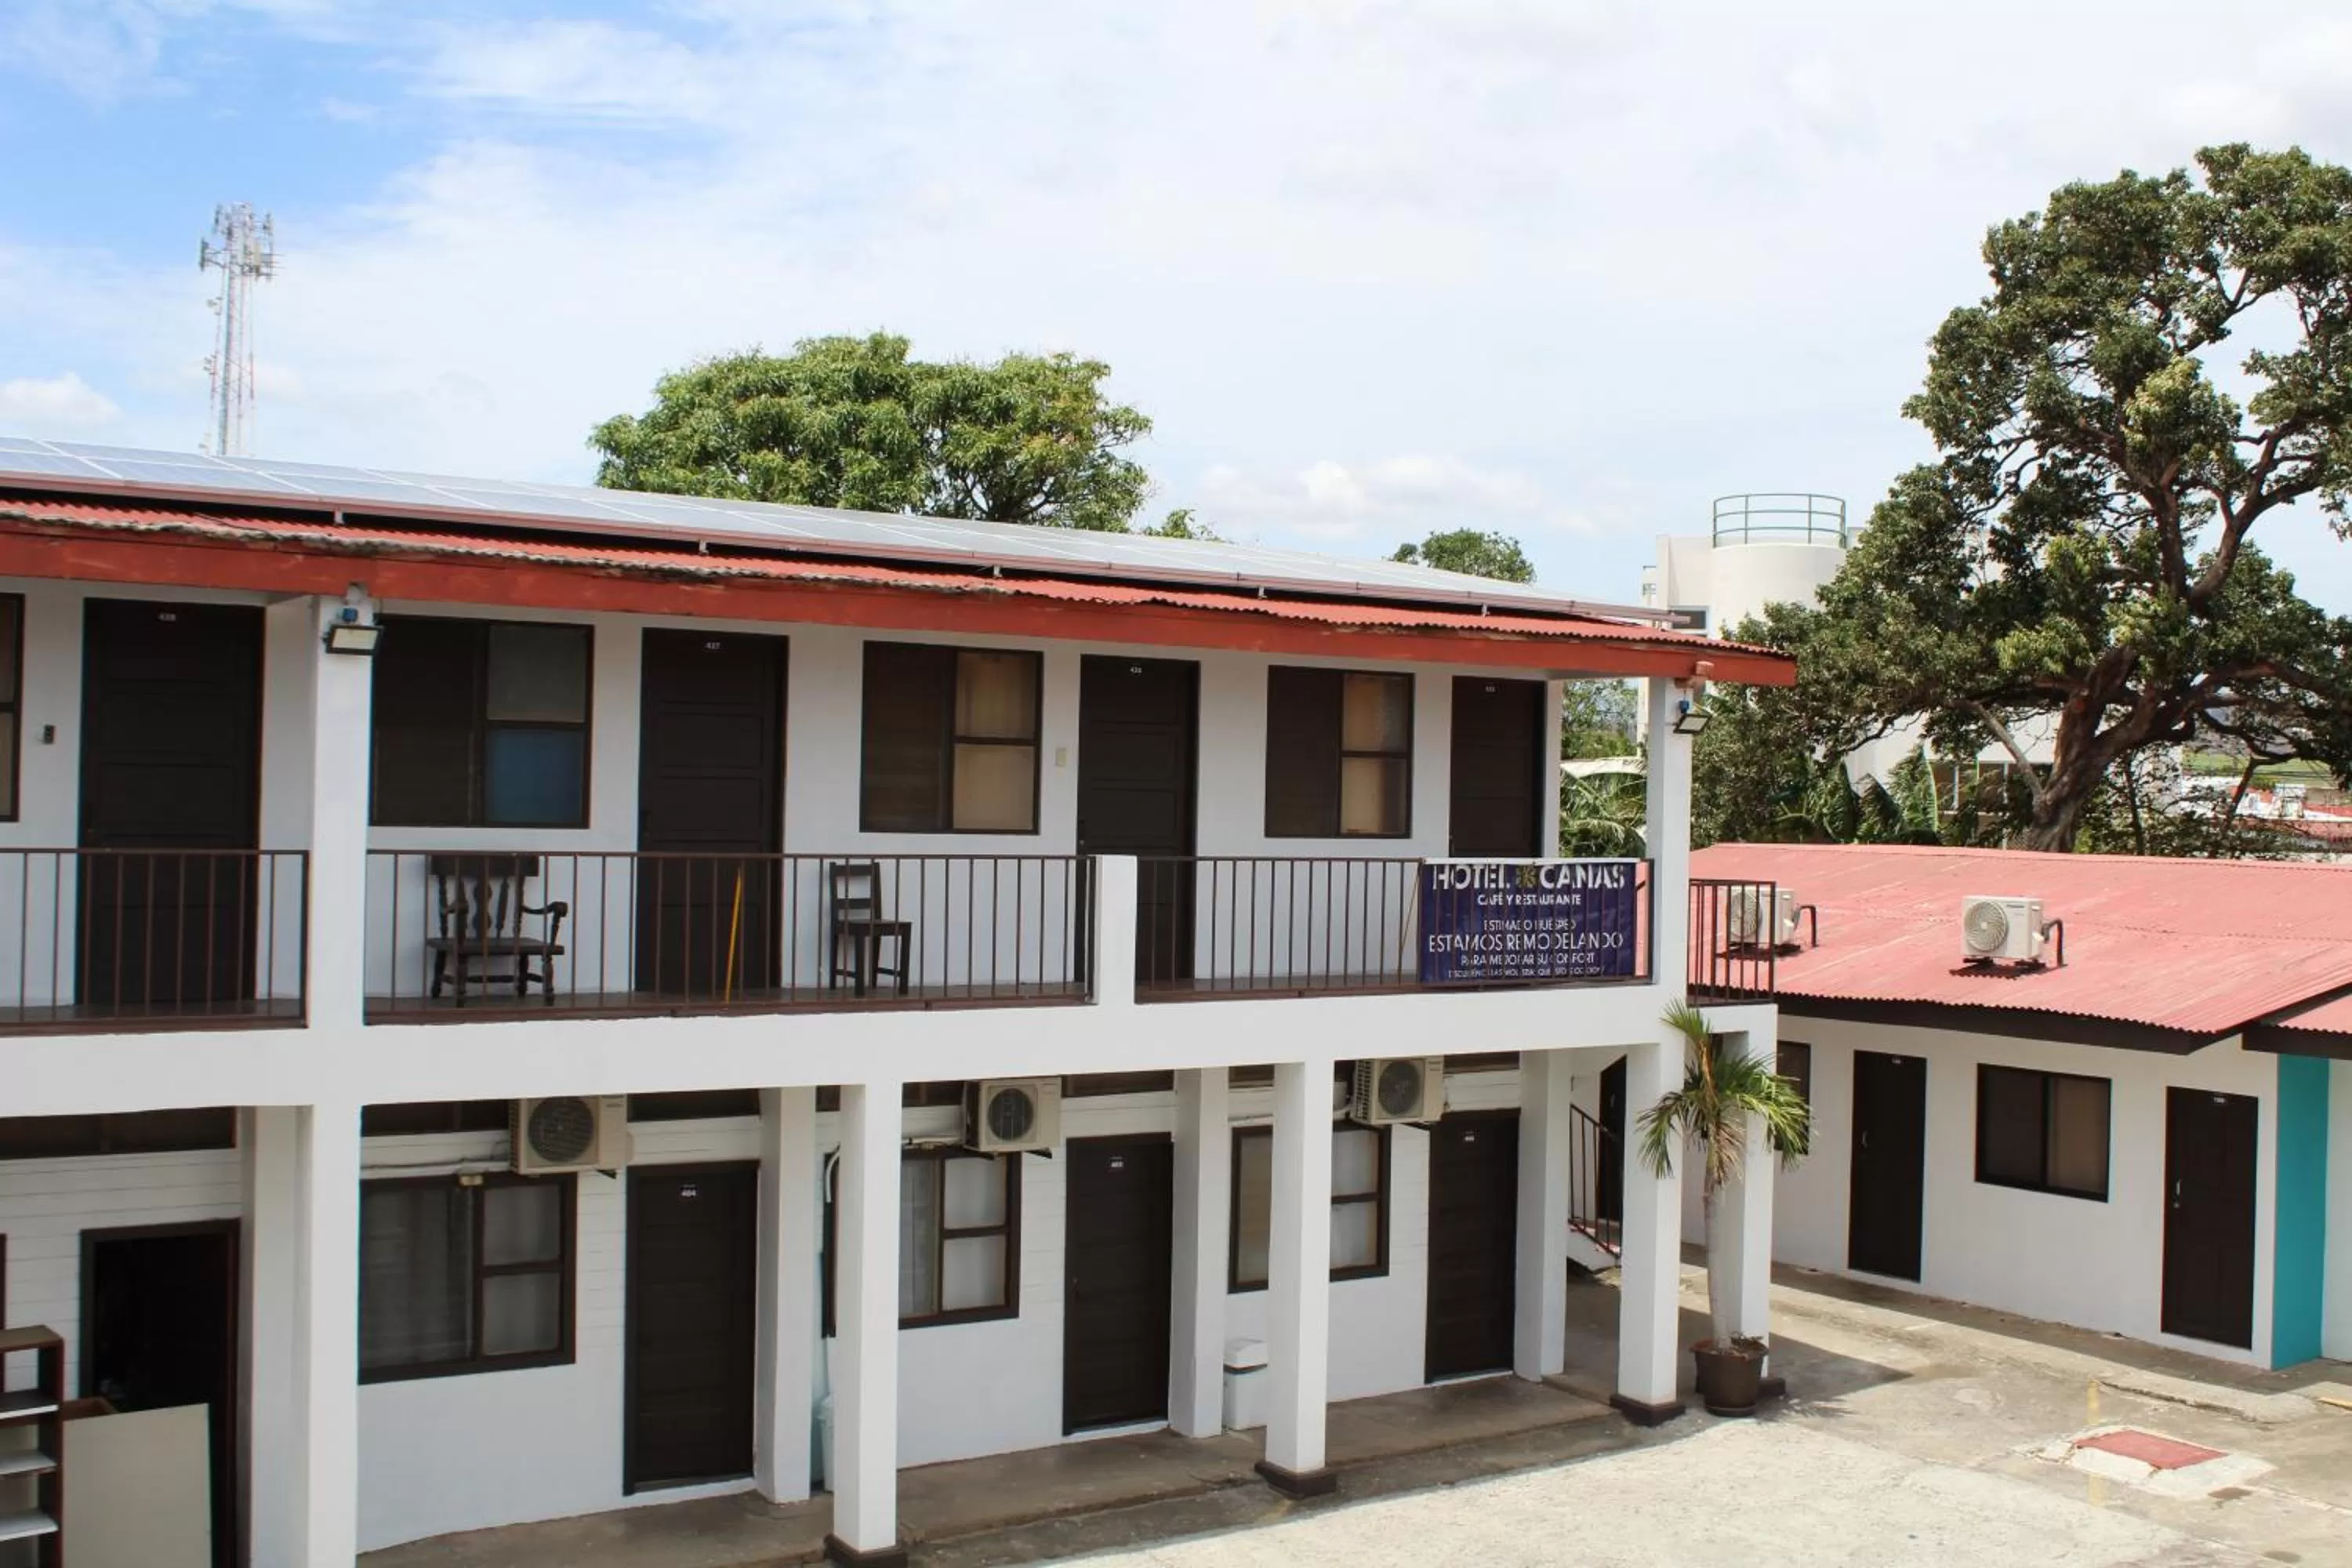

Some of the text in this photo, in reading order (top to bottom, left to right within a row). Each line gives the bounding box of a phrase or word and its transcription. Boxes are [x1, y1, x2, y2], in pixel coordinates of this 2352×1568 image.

[1432, 864, 1510, 890] HOTEL
[1506, 895, 1514, 906] Y
[1429, 931, 1624, 953] ESTAMOS REMODELANDO
